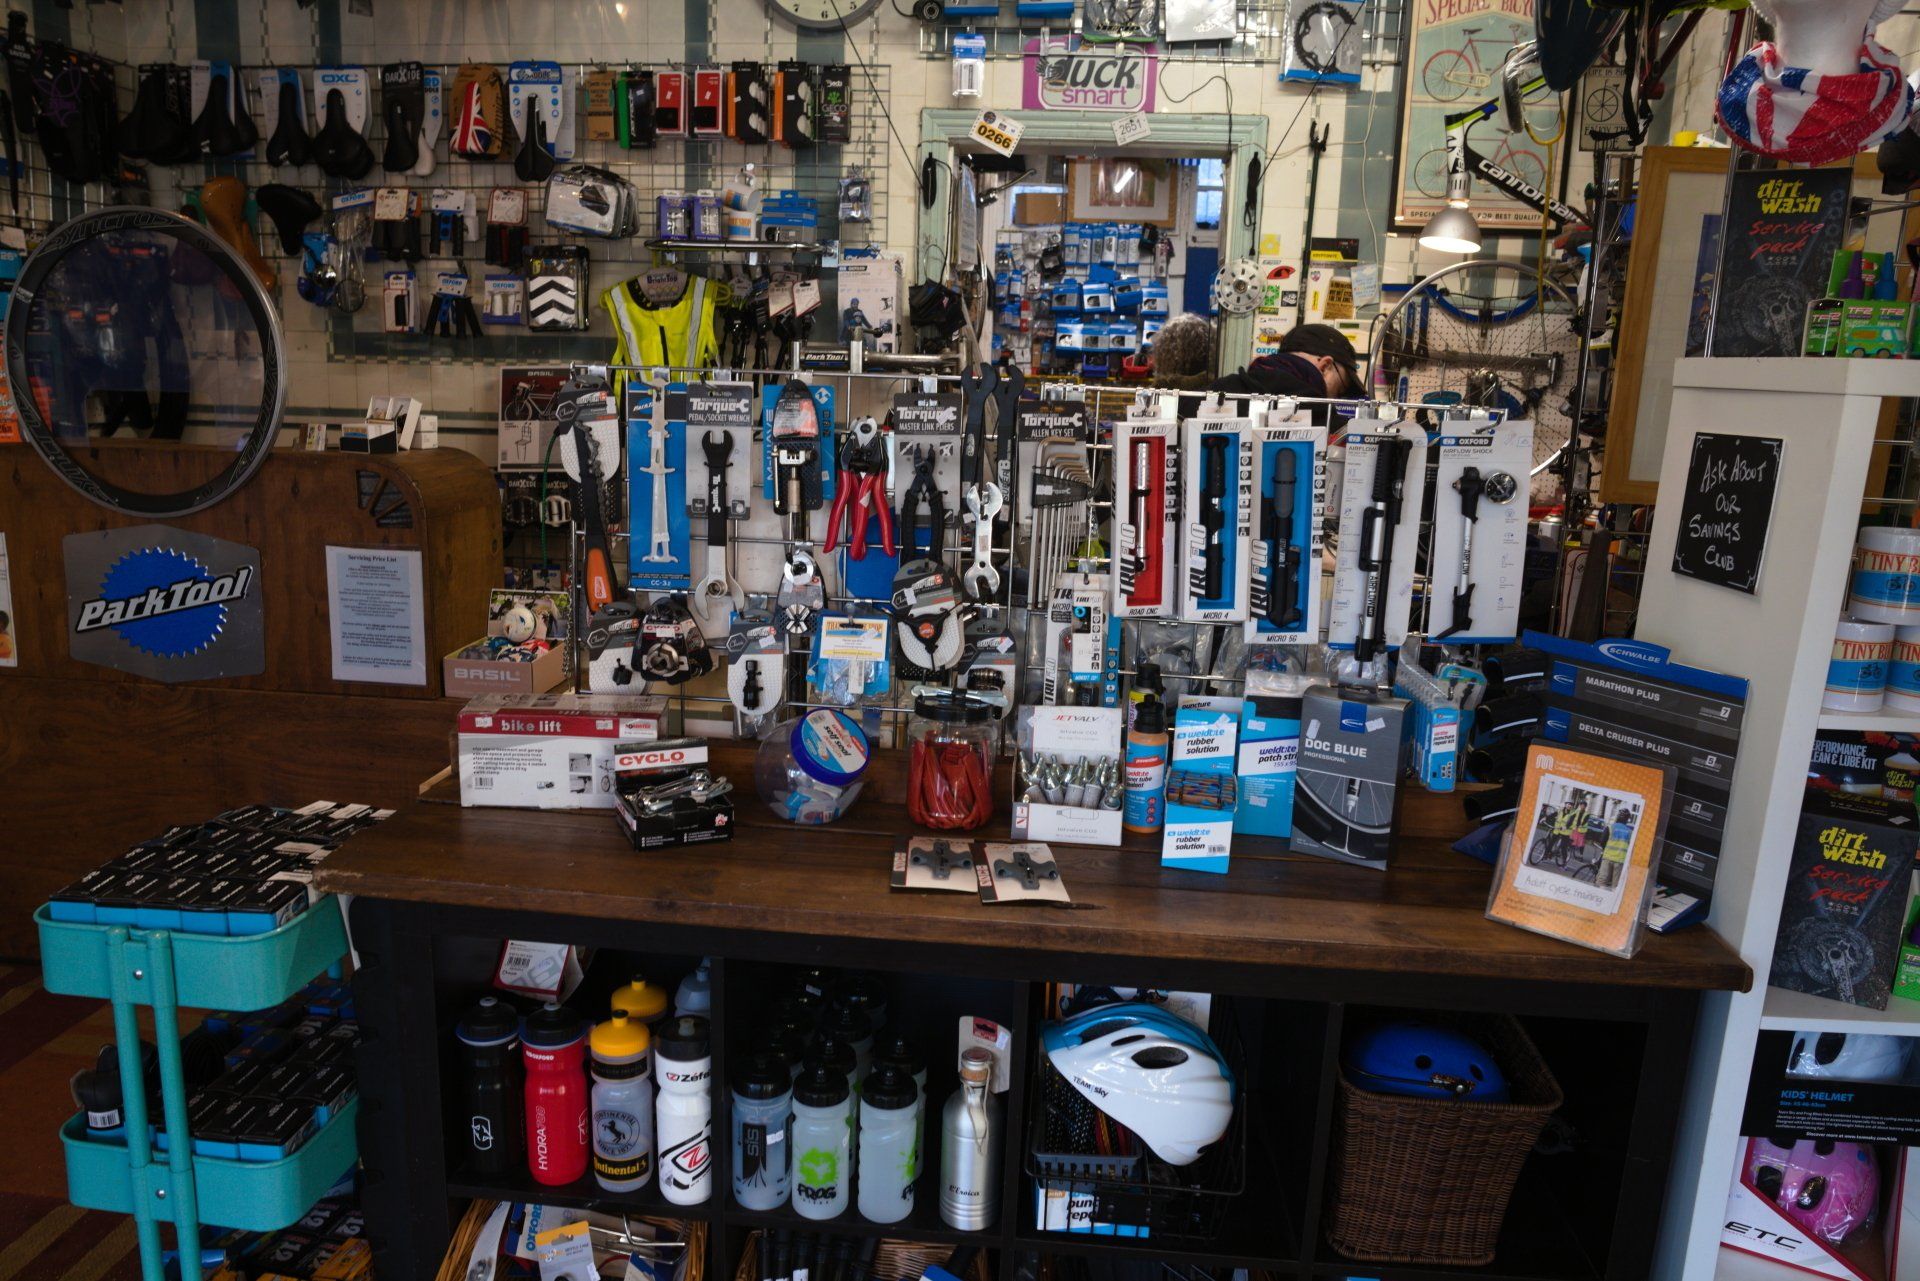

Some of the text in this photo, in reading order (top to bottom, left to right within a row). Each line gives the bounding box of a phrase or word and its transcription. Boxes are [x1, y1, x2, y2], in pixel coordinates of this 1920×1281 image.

[1062, 86, 1127, 105] smart
[822, 104, 847, 113] GECO
[1120, 118, 1143, 135] 2651
[977, 124, 1012, 150] 0266
[1757, 179, 1804, 199] dirt
[1761, 193, 1822, 214] wash
[898, 422, 920, 431] MASTER
[921, 422, 934, 431] LINK
[1031, 428, 1074, 438] ALLEN KEY SET
[1459, 438, 1490, 446] OXFORD
[1871, 554, 1903, 572] TINY
[76, 565, 253, 632] ParkTool
[1129, 608, 1145, 616] ROAD
[1609, 647, 1661, 664] SCHWALBE
[1842, 642, 1876, 659] TINY
[1899, 643, 1920, 660] TIN
[454, 668, 520, 682] BASIL
[1585, 676, 1634, 695] MARATHON
[1636, 689, 1660, 701] PLUS
[1722, 708, 1729, 717] 7
[1182, 701, 1211, 710] puncture
[501, 719, 562, 732] bike lift
[1187, 737, 1215, 746] rubber
[1304, 738, 1367, 758] DOC BLUE
[1579, 723, 1604, 736] DELTA
[1606, 731, 1644, 748] CRUISER
[1646, 742, 1670, 756] PLUS
[1186, 745, 1219, 755] solution
[1304, 751, 1347, 763] PROFESSIONAL
[1812, 740, 1867, 758] ERFORMANCE
[619, 752, 684, 766] CYCLO
[1258, 752, 1298, 764] patch stri
[1809, 753, 1830, 765] LEAN
[1839, 755, 1862, 768] LUBE
[1862, 757, 1878, 771] KIT
[1819, 826, 1868, 850] dirt
[1823, 843, 1887, 870] wash
[1073, 1076, 1110, 1098] TEAM sky
[1781, 1089, 1855, 1102] KIDS' HELMET
[797, 1183, 837, 1200] FROG
[1724, 1221, 1803, 1250] ETC
